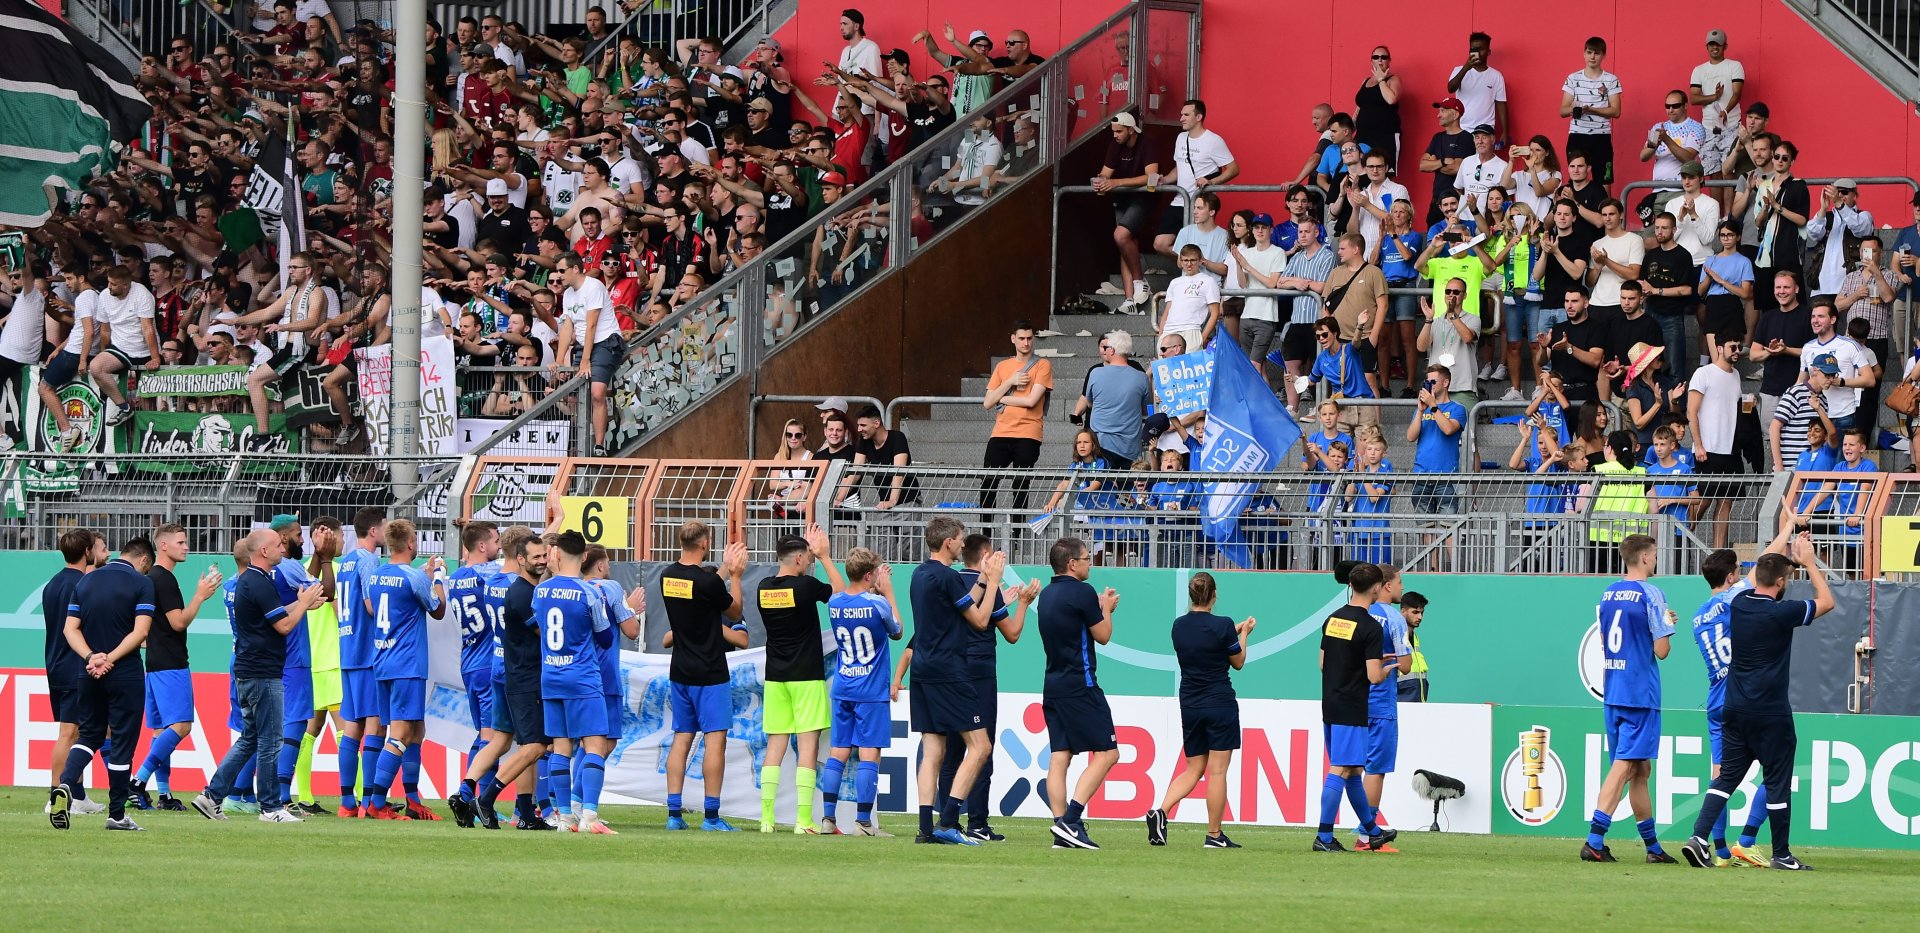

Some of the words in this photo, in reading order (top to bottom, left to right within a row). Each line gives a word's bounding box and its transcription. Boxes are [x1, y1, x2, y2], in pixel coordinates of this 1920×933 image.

[1165, 382, 1183, 402] gib
[1186, 382, 1204, 391] mir
[1176, 398, 1199, 411] dein
[141, 421, 189, 454] Linden
[582, 501, 603, 543] 6
[380, 576, 405, 588] SCHOTT
[551, 588, 583, 602] SCHOTT
[1614, 590, 1642, 603] SCHOTT
[377, 593, 391, 635] 4
[451, 594, 485, 636] 25
[547, 607, 564, 651] 8
[843, 607, 873, 619] SCHOTT
[1608, 609, 1623, 654] 6
[837, 626, 876, 665] 30
[1701, 623, 1732, 671] 16
[1087, 725, 1388, 827] BAN
